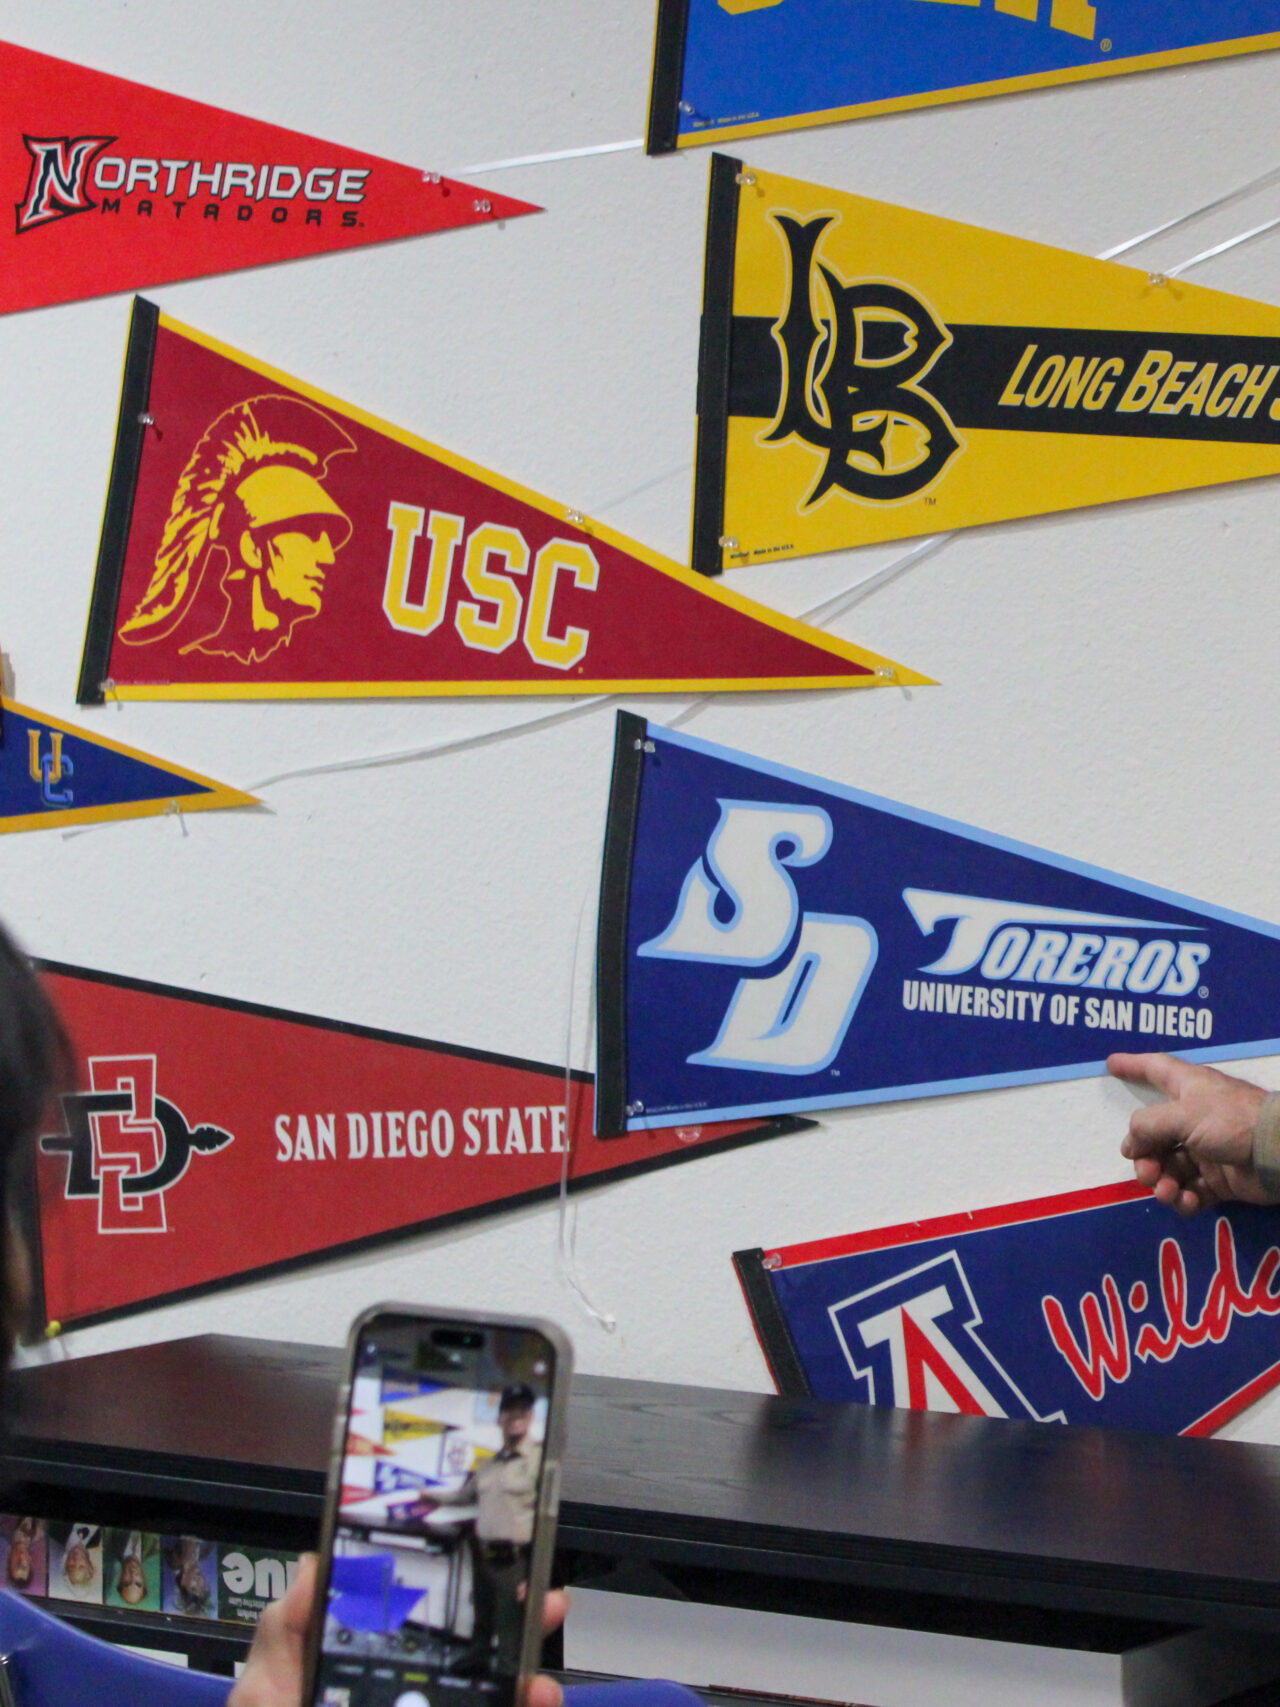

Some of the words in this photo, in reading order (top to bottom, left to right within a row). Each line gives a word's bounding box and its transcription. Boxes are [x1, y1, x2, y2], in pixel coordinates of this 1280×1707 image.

[15, 134, 372, 235] NORTHRIDGE
[102, 198, 361, 228] MATADORS
[998, 344, 1124, 411] LONG
[1115, 350, 1280, 419] BEACH
[382, 500, 600, 670] USC
[637, 797, 880, 1077] SD
[902, 886, 1212, 998] TOREROS
[902, 979, 1046, 1023] UNIVERSITY
[1050, 993, 1081, 1027] OF
[1084, 996, 1134, 1032] SAN
[1138, 1002, 1214, 1041] DIEGO
[274, 1113, 338, 1163] SAN
[346, 1108, 456, 1160] DIEGO
[462, 1104, 571, 1157] STATE
